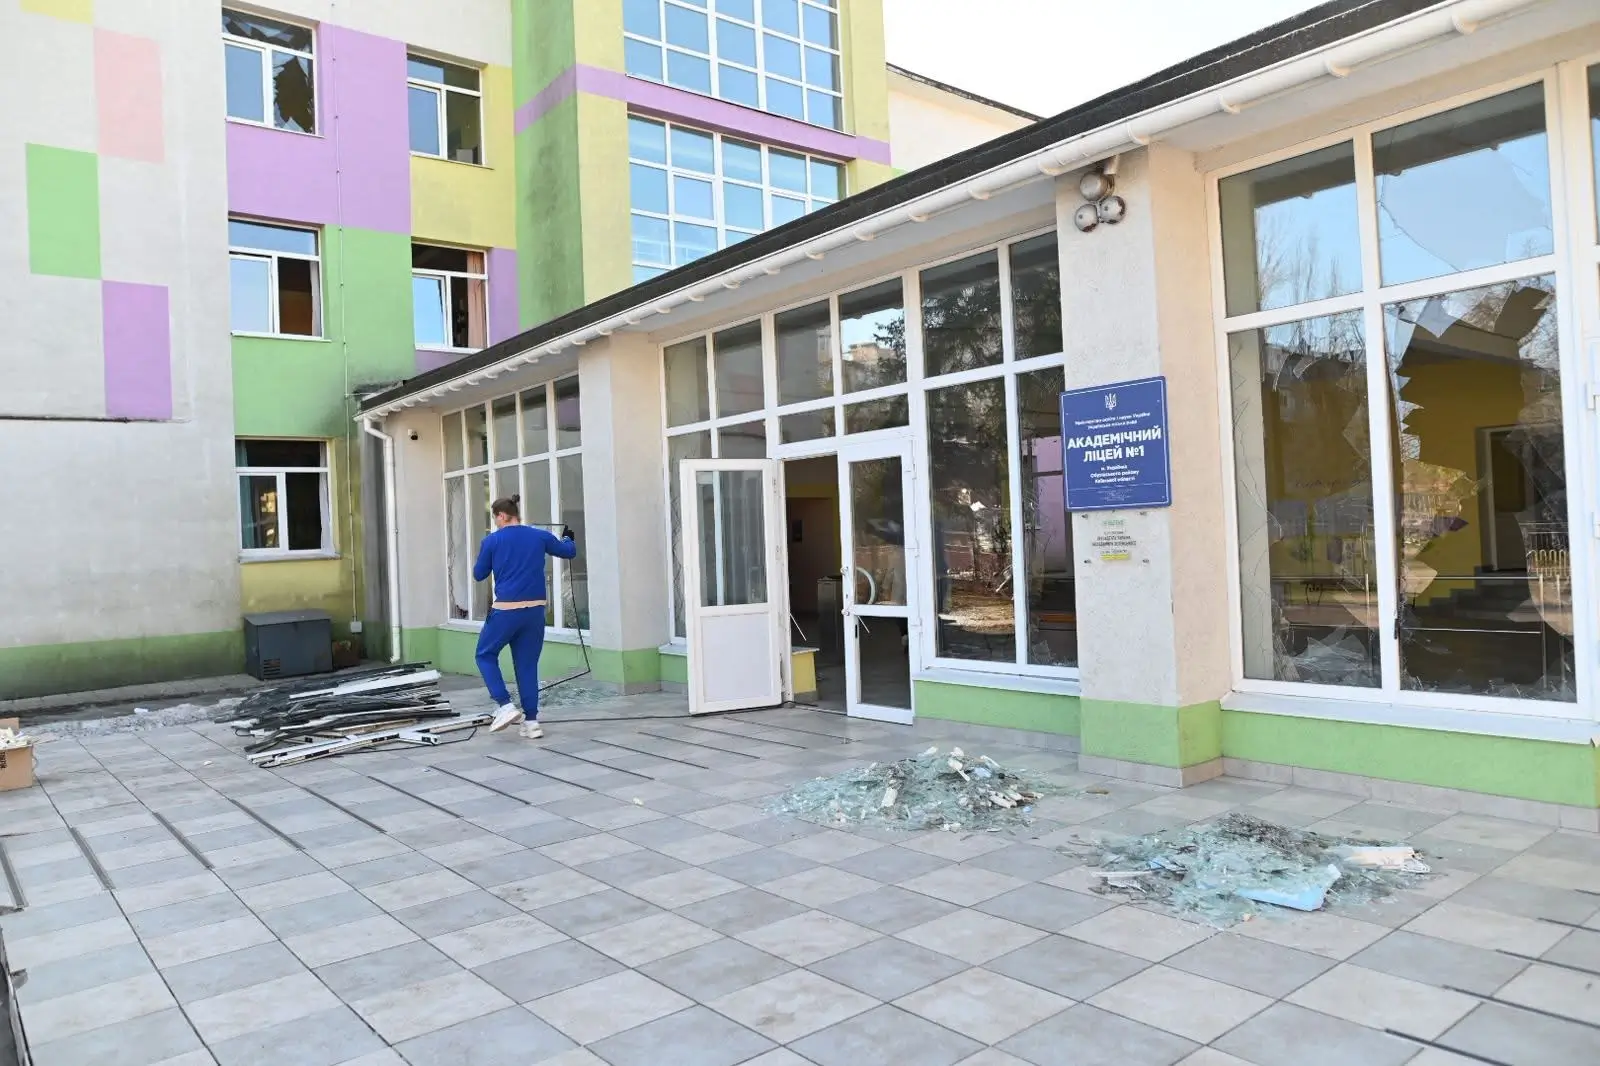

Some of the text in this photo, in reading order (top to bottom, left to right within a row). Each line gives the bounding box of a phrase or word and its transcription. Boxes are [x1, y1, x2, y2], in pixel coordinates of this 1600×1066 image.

[1067, 425, 1161, 449] АКАДЕМІЧНИЙ
[1083, 445, 1144, 462] ЛІЦЕЙ №1
